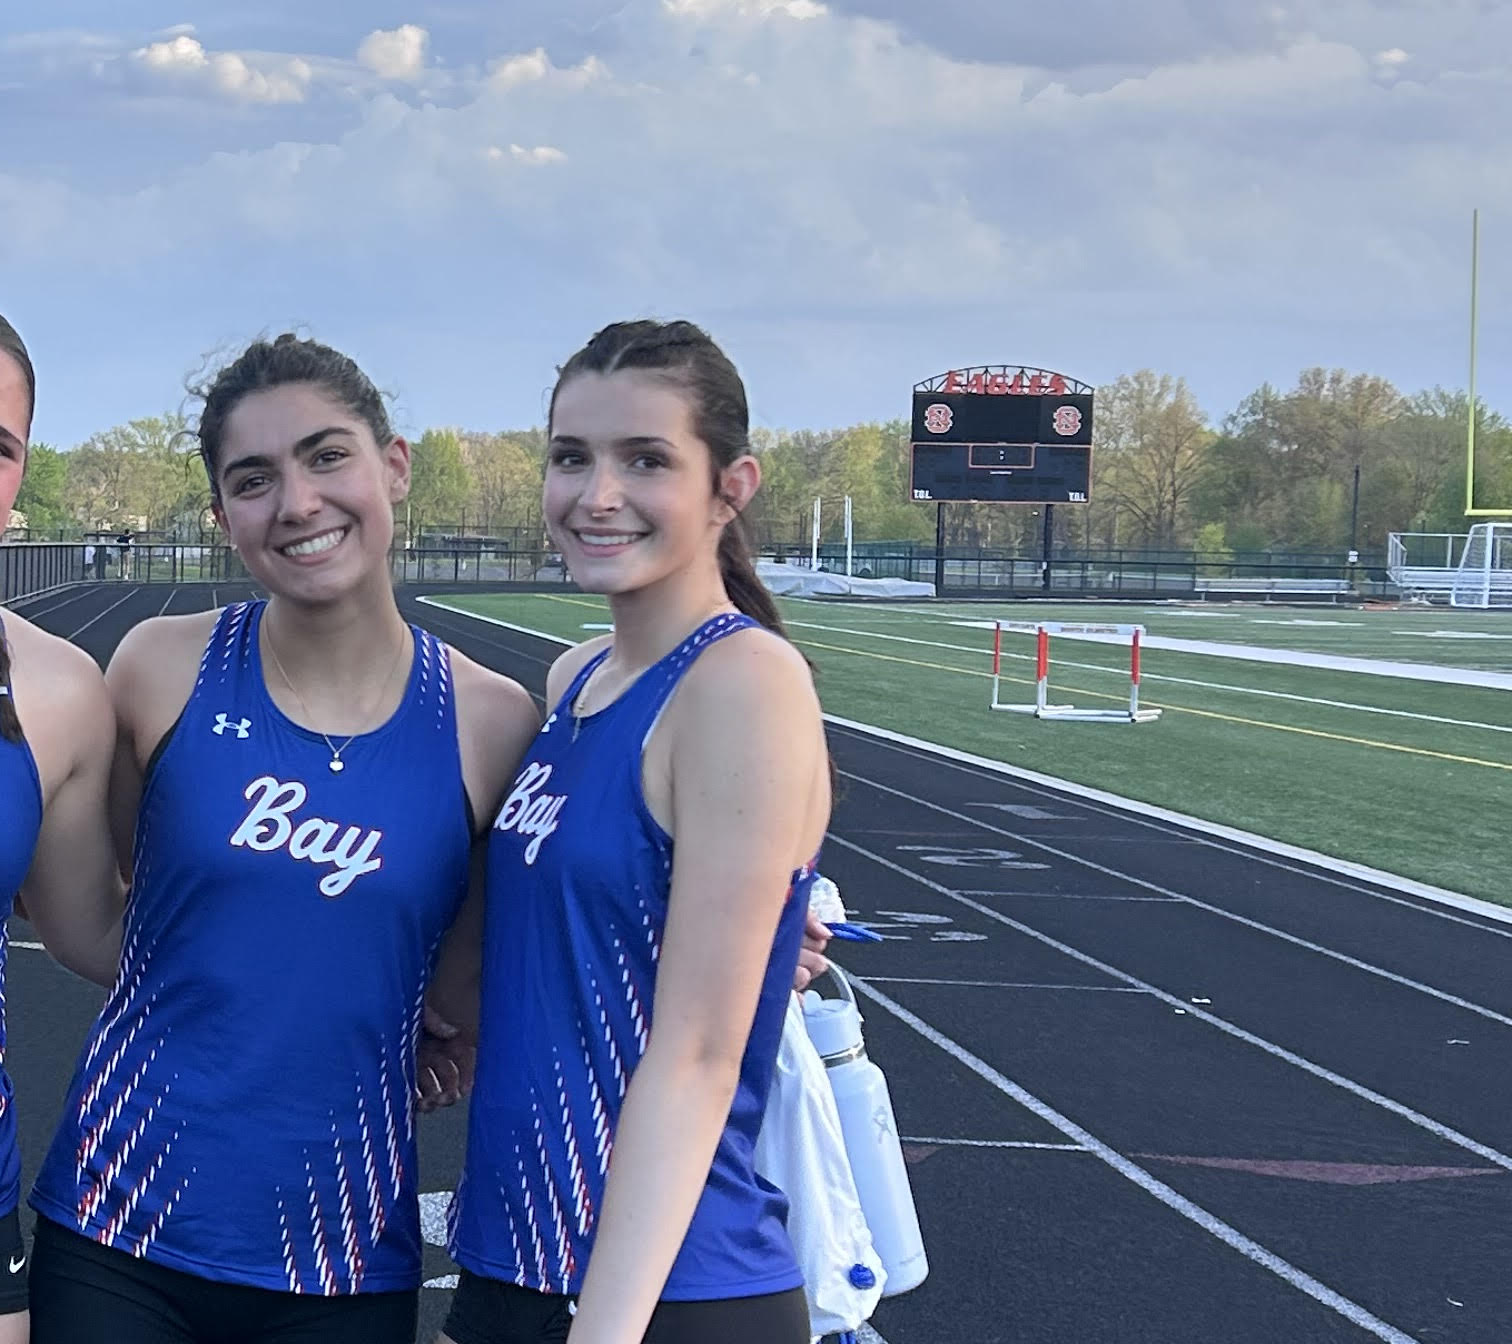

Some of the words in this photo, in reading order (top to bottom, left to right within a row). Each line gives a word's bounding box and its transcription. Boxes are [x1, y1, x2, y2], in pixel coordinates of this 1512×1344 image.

[945, 371, 1066, 396] EAGLES
[229, 775, 383, 898] Bay
[493, 761, 564, 866] Bay
